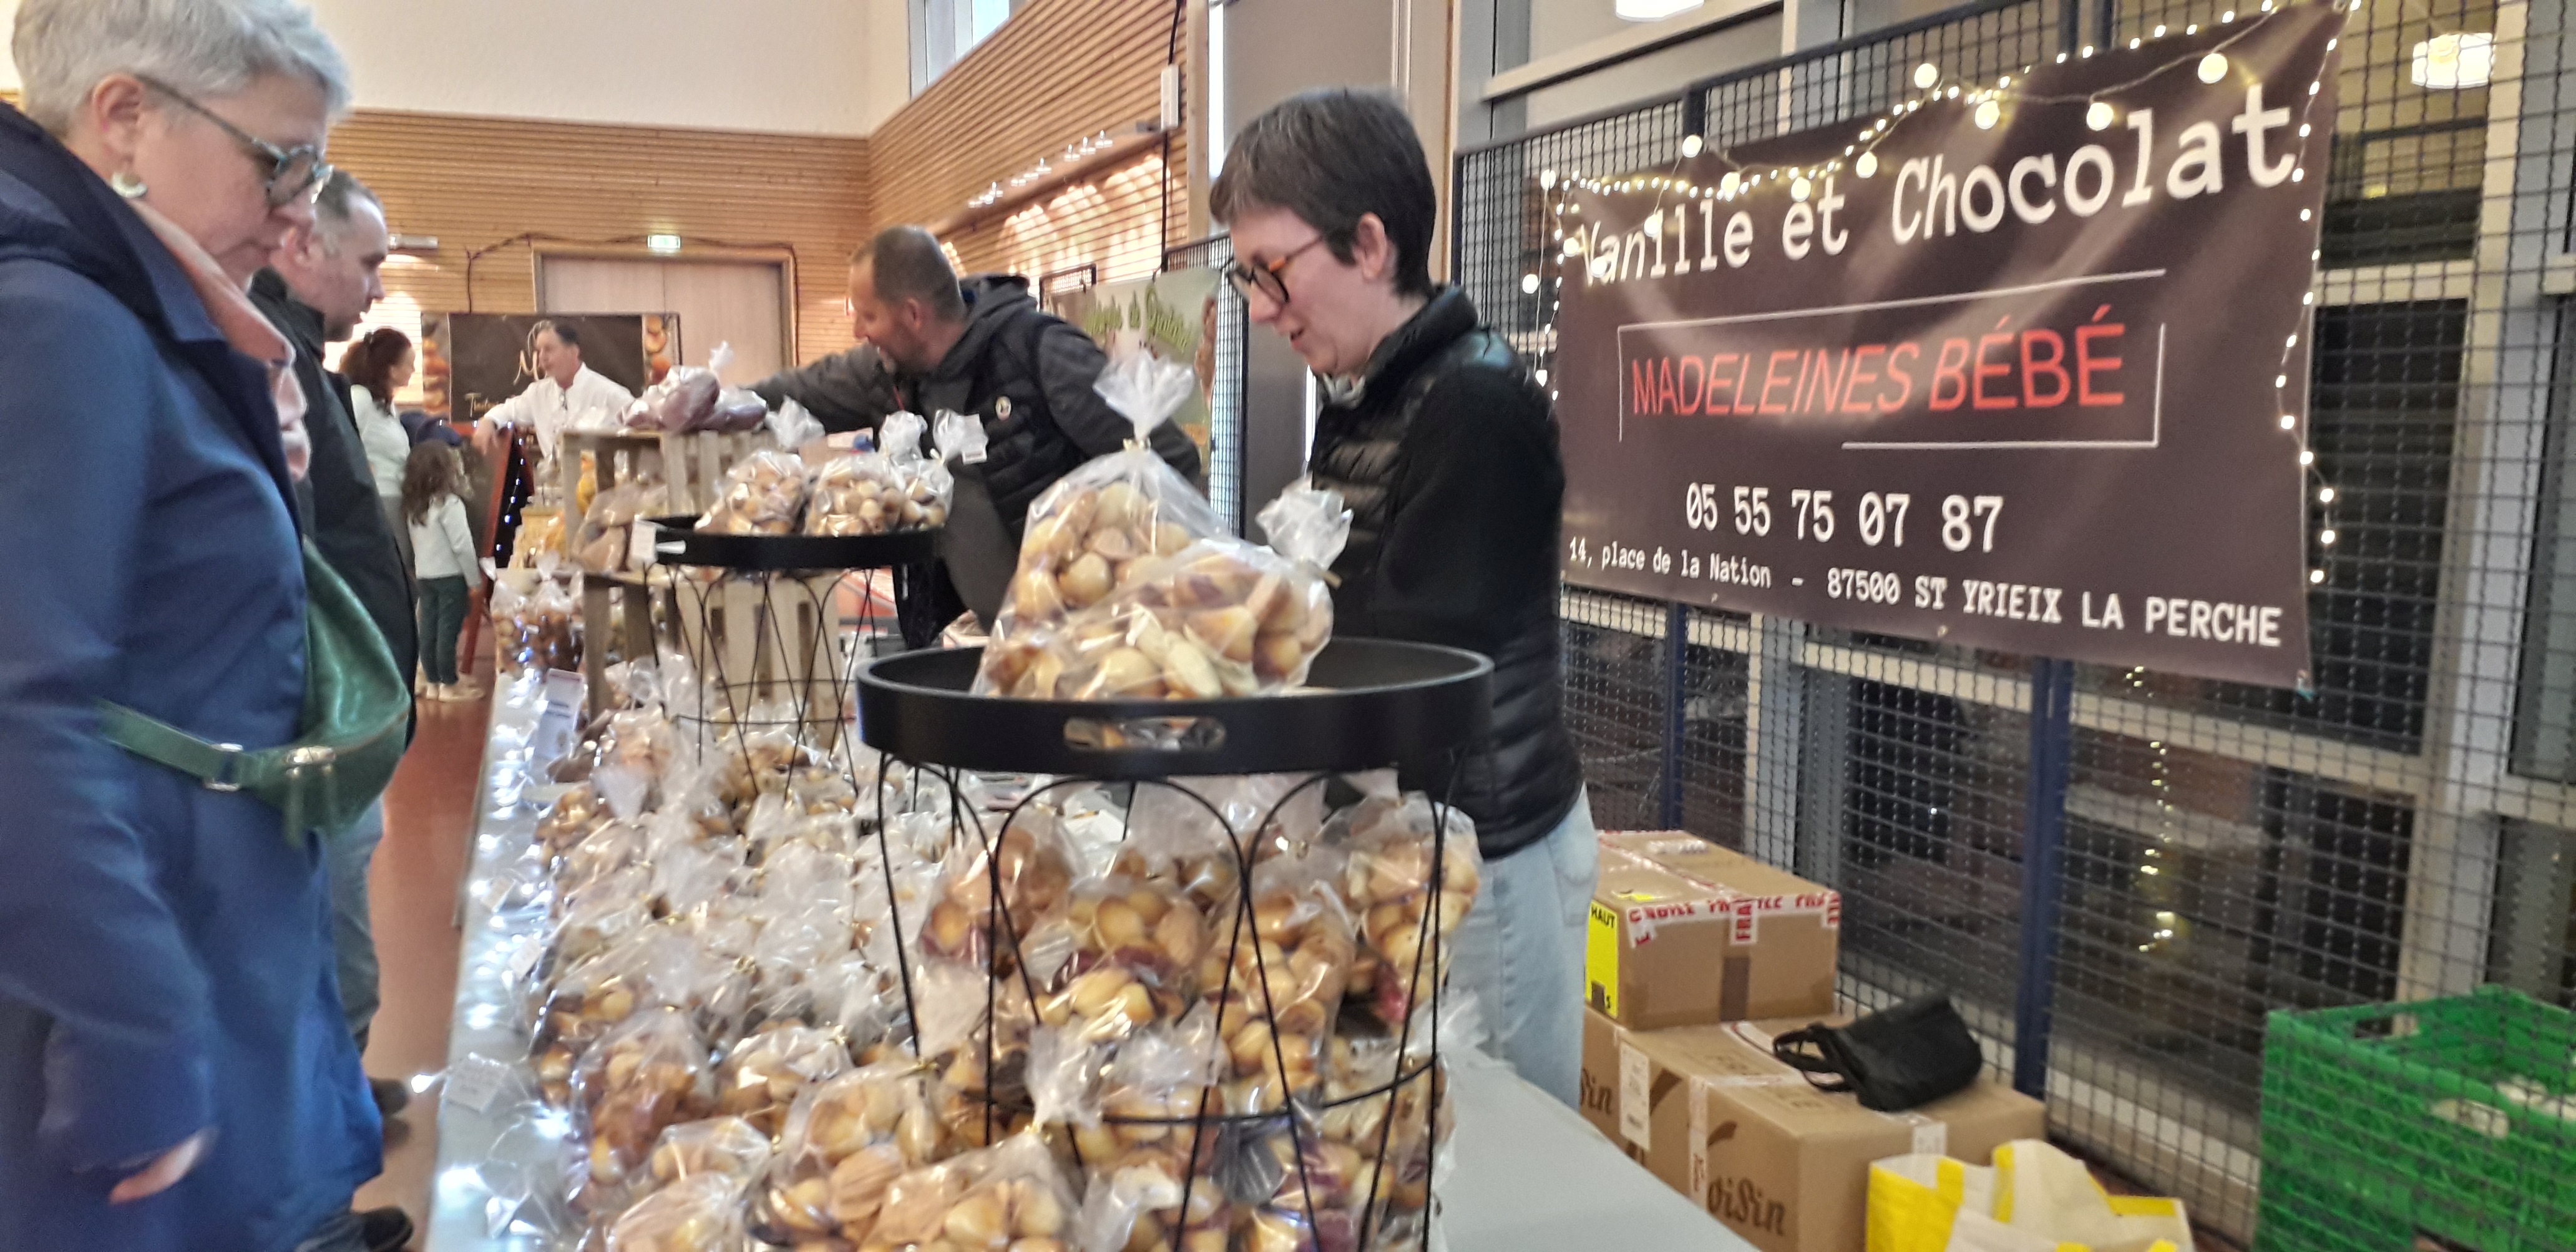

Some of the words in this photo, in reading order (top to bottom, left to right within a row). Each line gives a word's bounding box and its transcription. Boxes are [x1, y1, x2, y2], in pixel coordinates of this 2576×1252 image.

[1581, 198, 1754, 286] Vanille
[1782, 177, 1848, 260] et
[1892, 83, 2296, 245] Chocolat
[1633, 342, 1920, 416] MADELEINES
[1930, 305, 2126, 412] BÉBÉ
[1687, 482, 1719, 531] 05
[1734, 486, 1771, 537] 55
[1792, 489, 1835, 542] 75
[1859, 492, 1910, 547] 07
[1942, 495, 2003, 553] 87
[1569, 536, 1593, 569] 14,
[1602, 541, 1645, 571] place
[1652, 546, 1672, 575] de
[1681, 550, 1700, 579] la
[1710, 553, 1772, 589] Nation
[1828, 567, 1901, 605] 87500
[1915, 575, 1947, 610] ST
[1963, 580, 2062, 624] YRIEIX
[2082, 592, 2125, 630] LA
[2145, 597, 2282, 647] PERCHE
[1591, 906, 1616, 929] HAUT
